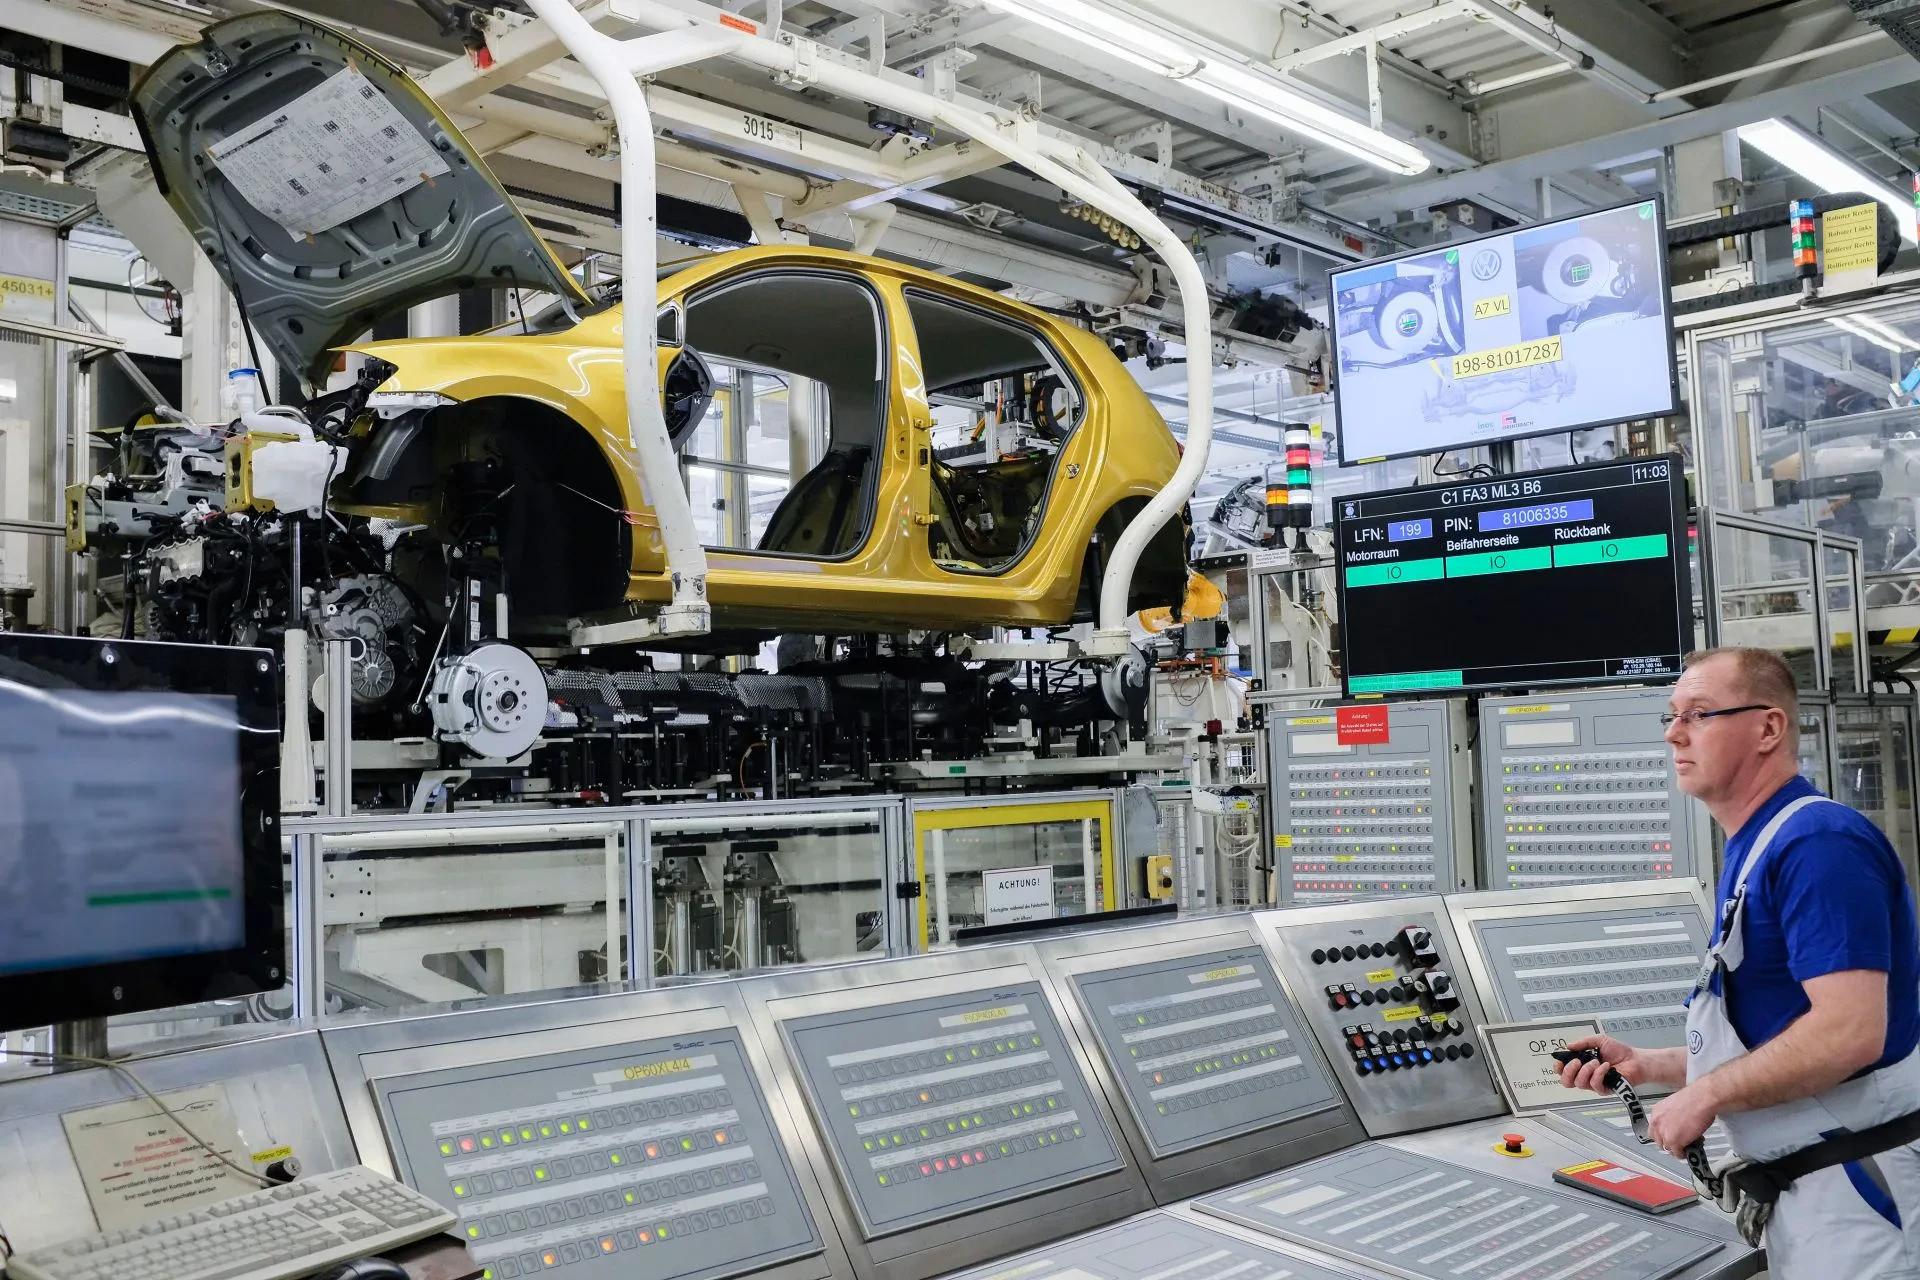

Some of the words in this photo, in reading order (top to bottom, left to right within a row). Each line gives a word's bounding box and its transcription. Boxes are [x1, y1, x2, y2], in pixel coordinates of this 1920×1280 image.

[743, 115, 774, 141] 3015
[1474, 302, 1490, 317] A7
[1493, 299, 1509, 312] VL
[1455, 341, 1560, 375] 198-81017287
[1634, 464, 1668, 480] 11:03
[1441, 490, 1459, 505] C1
[1462, 487, 1488, 502] FA3
[1491, 483, 1520, 499] ML3
[1523, 480, 1542, 495] B6
[1444, 516, 1473, 533] PIN:
[1502, 505, 1568, 526] 81006335
[1354, 527, 1384, 543] LFN:
[1399, 523, 1422, 537] 199
[1554, 523, 1611, 540] Rückbank
[1446, 533, 1520, 552] Beifahrerseite
[1346, 548, 1400, 562] Motorraum
[999, 877, 1041, 890] ACHTUNG!
[1528, 1040, 1547, 1054] OP
[1550, 1038, 1568, 1051] 50
[623, 1058, 691, 1080] OP60XL4/4
[1513, 1081, 1536, 1090] Fügen
[1537, 1078, 1562, 1087] Fahrwe
